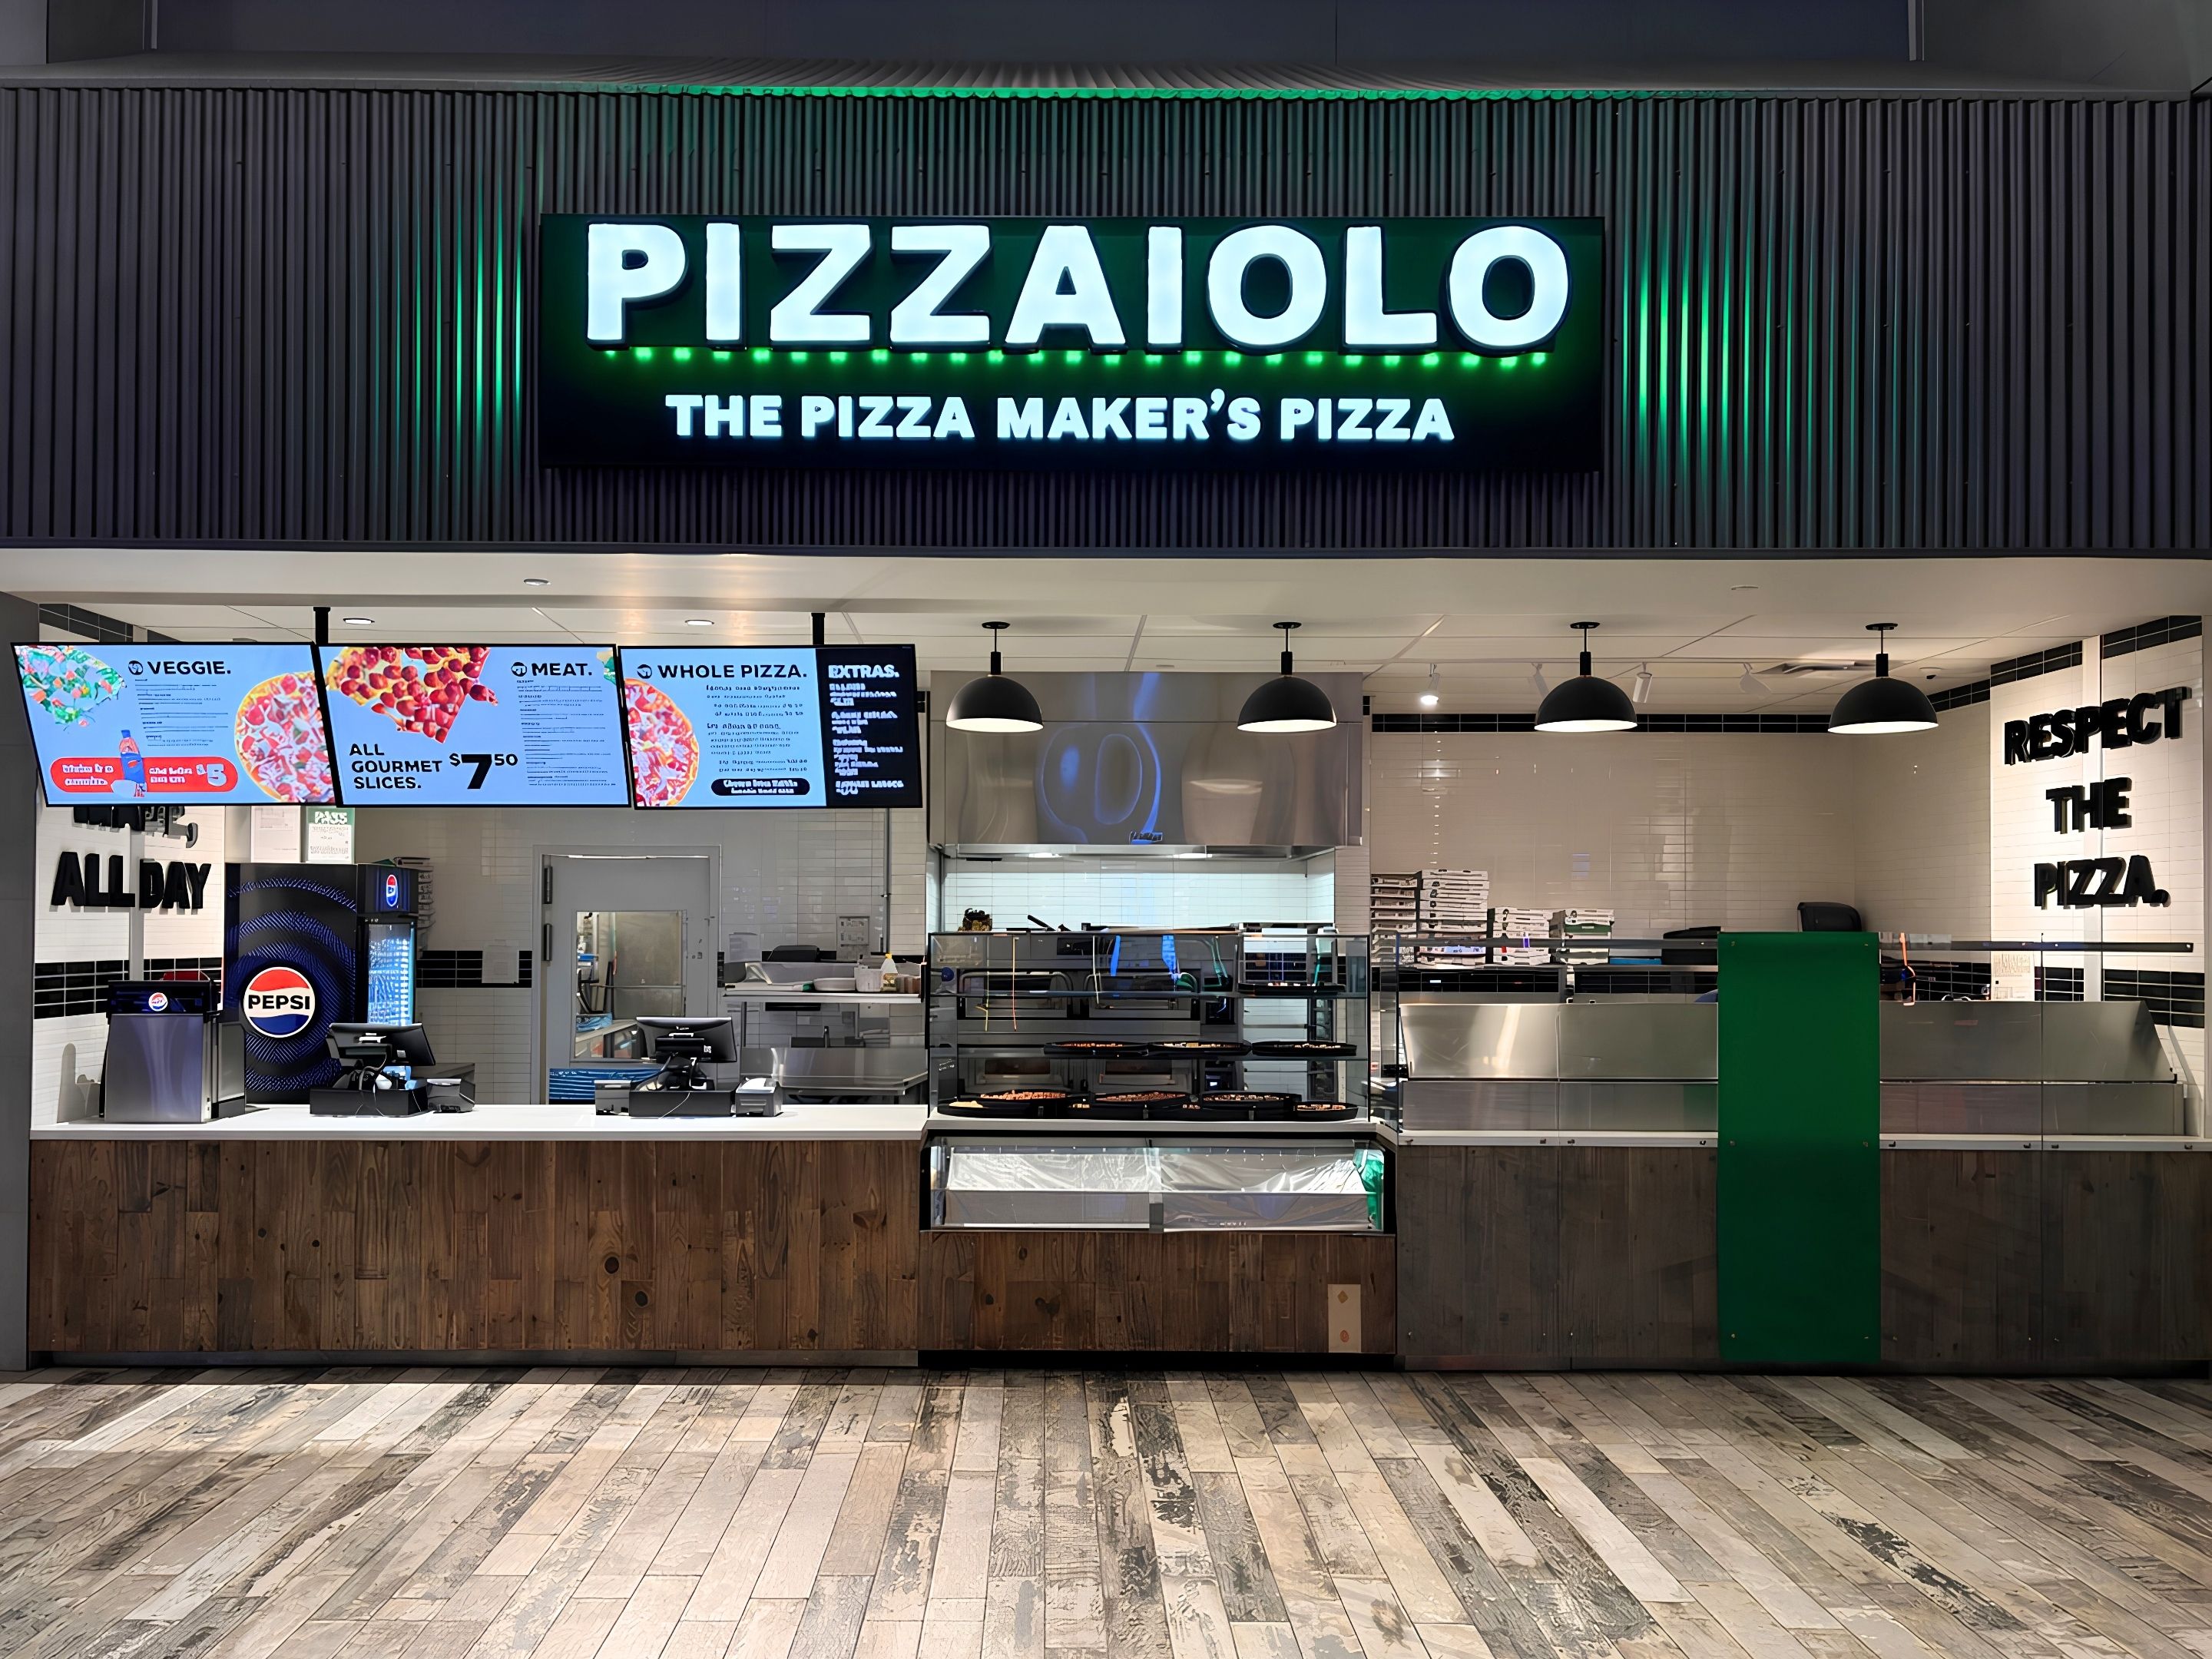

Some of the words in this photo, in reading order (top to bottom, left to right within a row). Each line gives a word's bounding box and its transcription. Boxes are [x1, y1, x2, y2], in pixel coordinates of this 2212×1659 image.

[586, 222, 1571, 349] PIZZAIOLO
[665, 394, 783, 438] THE
[800, 395, 975, 439] PIZZA
[997, 388, 1262, 441] MAKER'S
[1280, 397, 1455, 441] PIZZA
[147, 660, 231, 675] VEGGIE.
[531, 662, 592, 677] MEAT.
[657, 664, 735, 678] WHOLE
[740, 664, 808, 678] PIZZA.
[827, 664, 900, 679] EXTRAS.
[2004, 686, 2193, 767] RESPECT
[348, 743, 385, 757] ALL
[351, 759, 443, 773] GOURMET
[354, 776, 422, 790] SLICES.
[2045, 777, 2133, 835] THE
[51, 850, 136, 908] ALL
[139, 858, 212, 910] DAY
[2034, 854, 2171, 910] PIZZA.
[248, 995, 310, 1010] PEPSI
